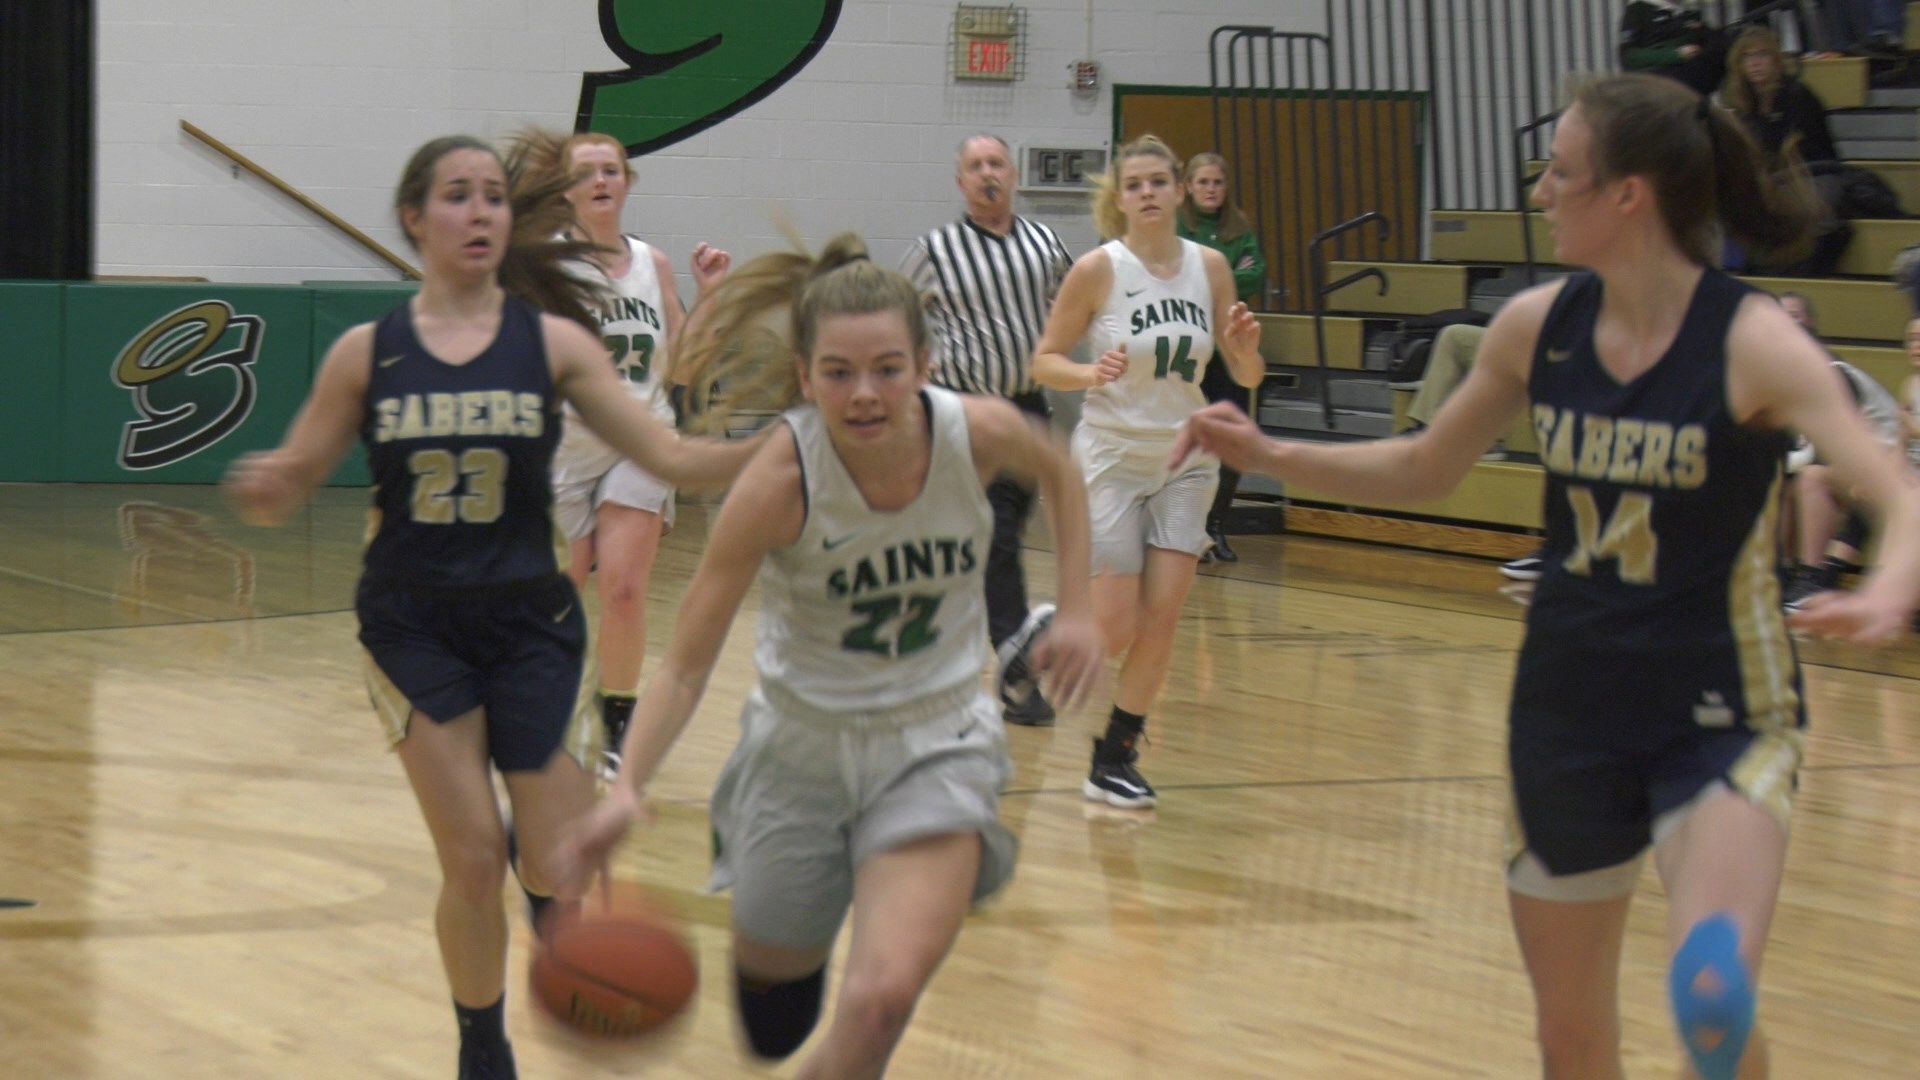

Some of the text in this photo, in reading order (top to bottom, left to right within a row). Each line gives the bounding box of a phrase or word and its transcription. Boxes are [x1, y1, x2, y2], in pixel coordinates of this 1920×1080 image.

[968, 41, 1008, 73] EXIT
[589, 297, 660, 331] AINTS
[1130, 299, 1208, 335] SAINTS
[1154, 336, 1197, 383] 14
[375, 391, 543, 443] SABERS
[409, 449, 508, 524] 23
[1562, 486, 1658, 586] 14
[827, 536, 976, 598] SAINTS
[842, 593, 946, 658] 22
